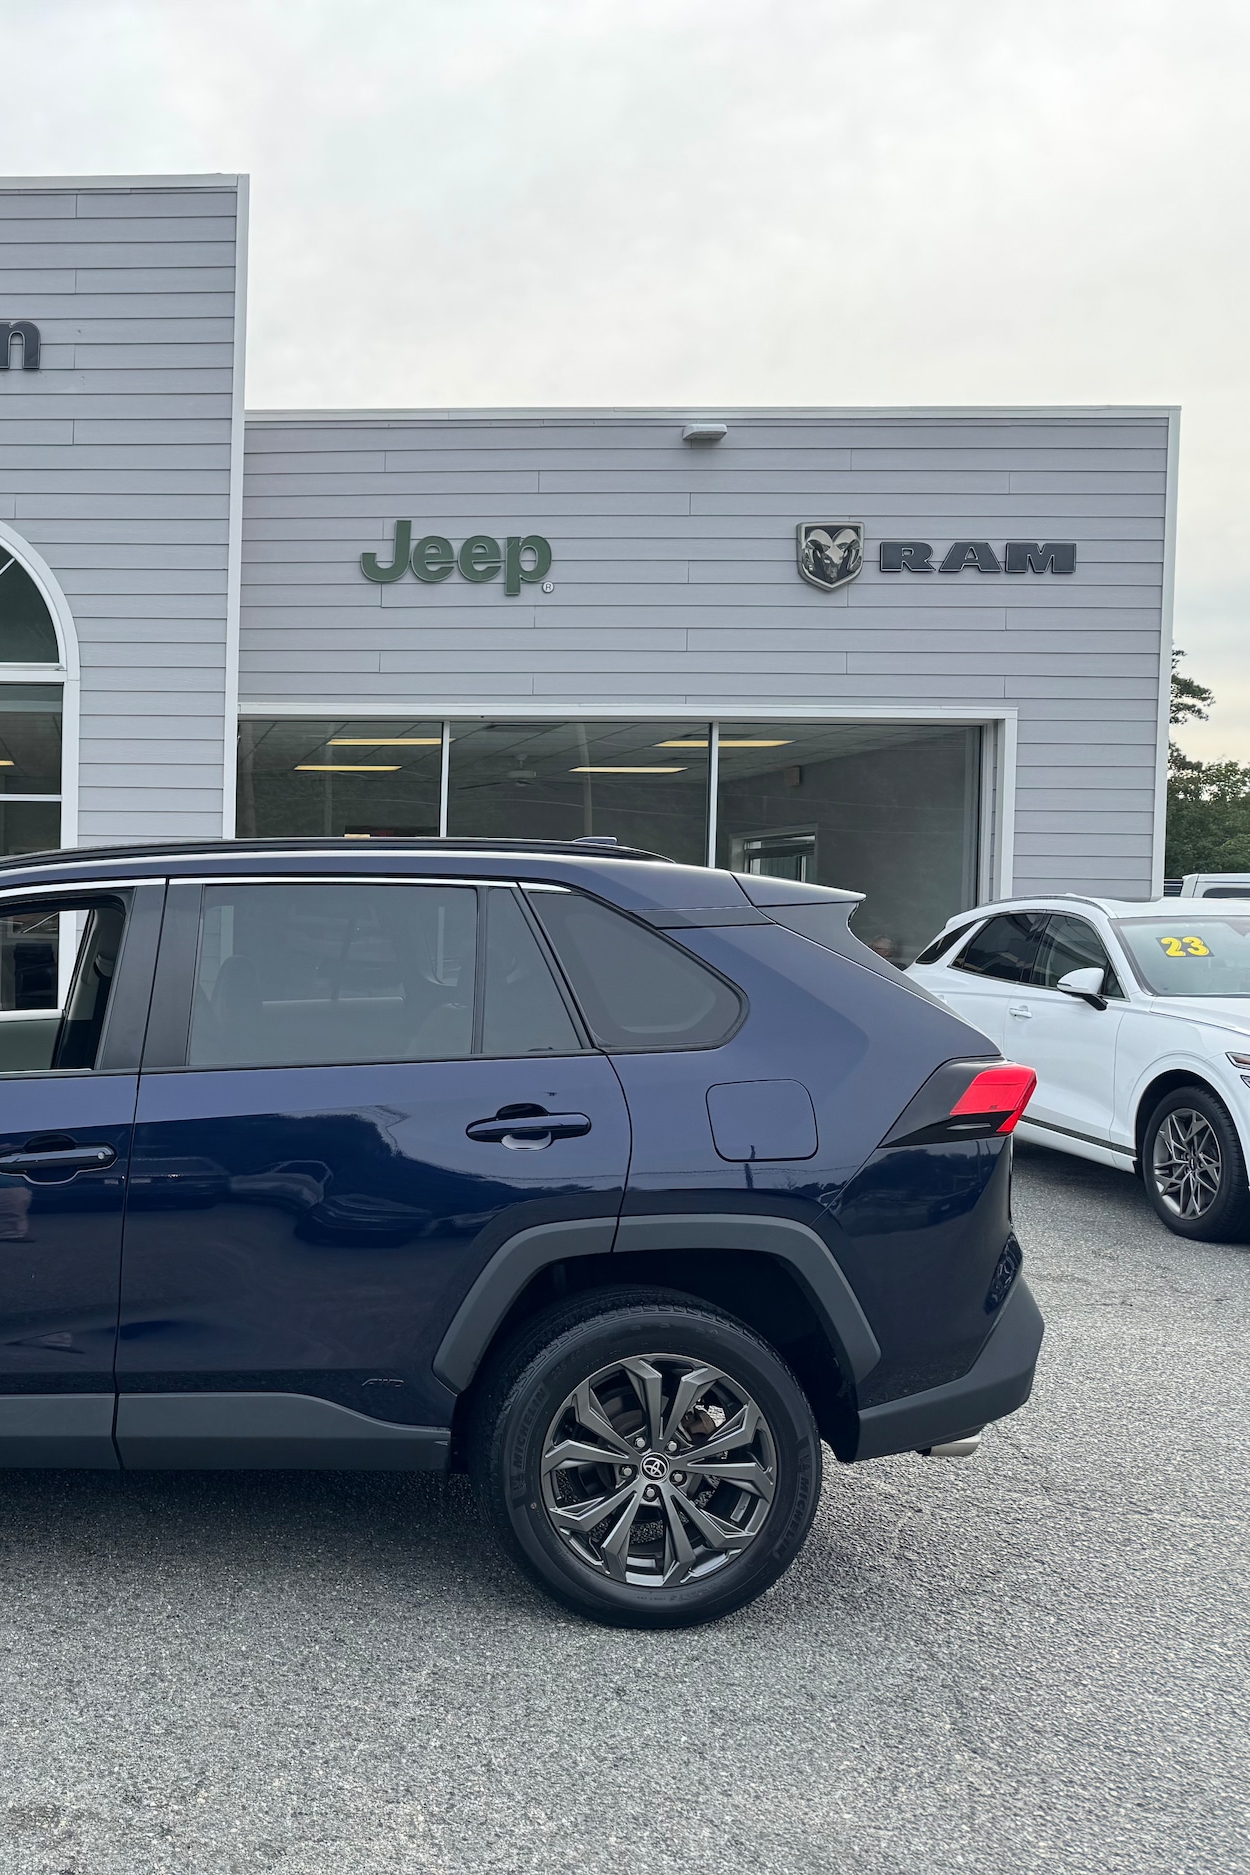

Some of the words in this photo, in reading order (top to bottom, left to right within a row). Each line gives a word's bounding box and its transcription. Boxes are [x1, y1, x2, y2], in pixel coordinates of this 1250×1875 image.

[360, 519, 552, 596] Jeep
[880, 541, 1077, 573] RAM
[1160, 936, 1210, 957] 23
[512, 1386, 546, 1469] MICHELIN
[775, 1477, 810, 1560] MICHELIN
